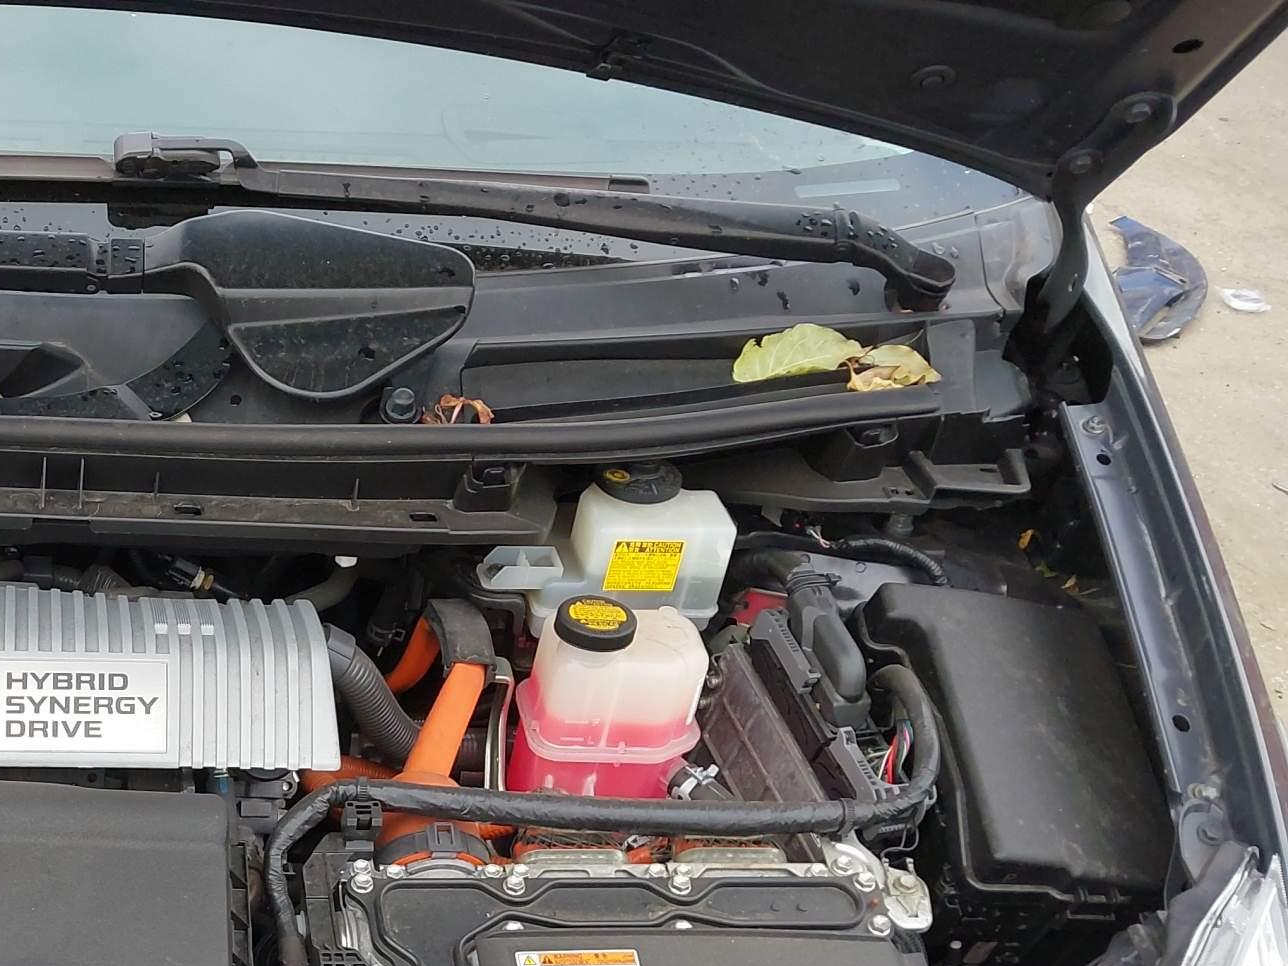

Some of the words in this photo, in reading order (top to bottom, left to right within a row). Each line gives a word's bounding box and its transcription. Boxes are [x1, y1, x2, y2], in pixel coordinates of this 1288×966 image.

[6, 672, 129, 691] HYBRID
[5, 695, 159, 715] SYNERGY
[5, 719, 103, 738] DRIVE
